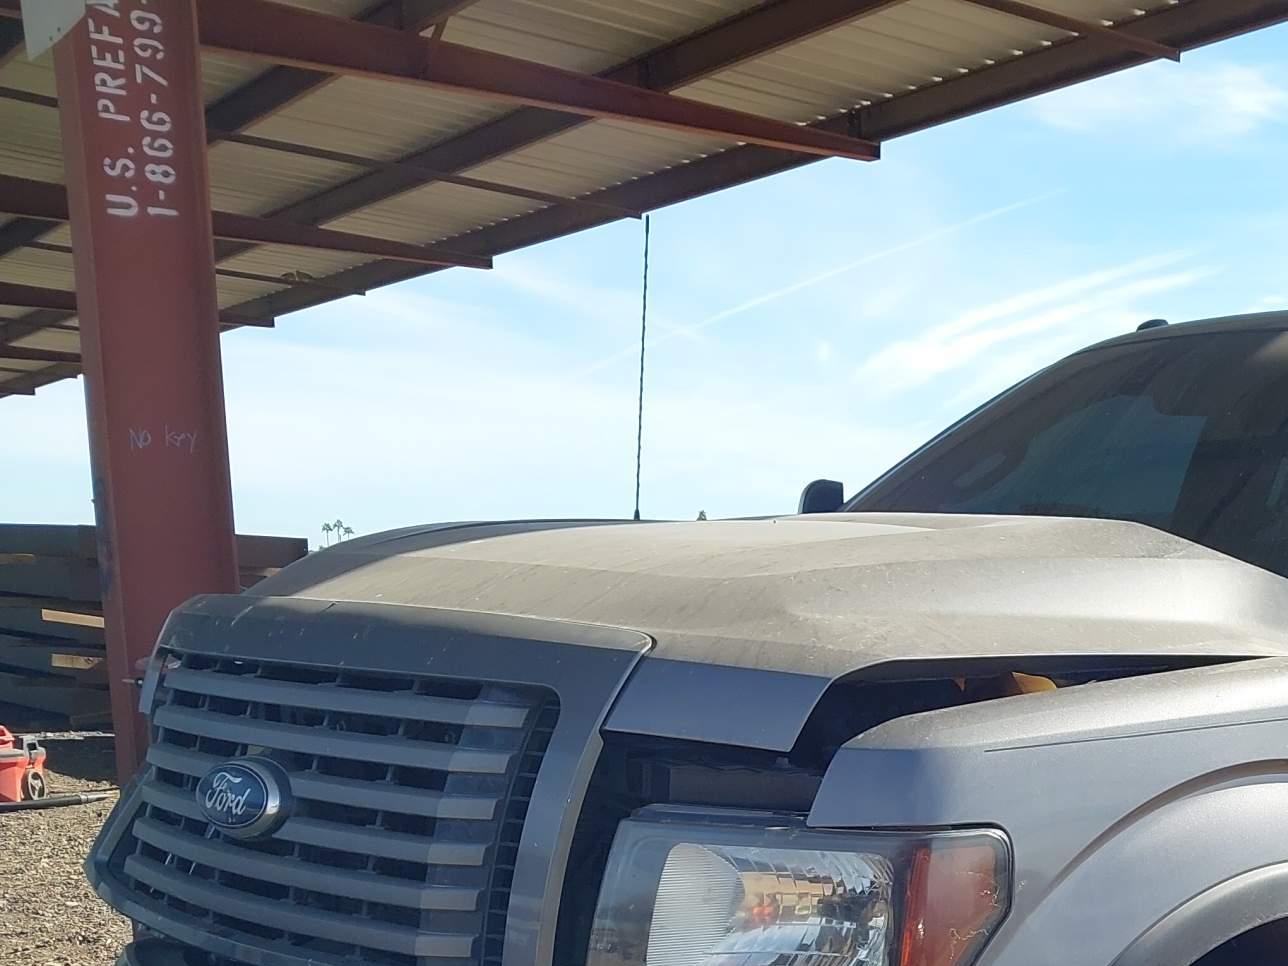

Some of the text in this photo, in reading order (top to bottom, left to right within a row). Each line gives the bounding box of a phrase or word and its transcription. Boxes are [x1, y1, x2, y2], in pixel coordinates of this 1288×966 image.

[130, 0, 179, 216] 1-866-799
[103, 146, 138, 217] U.S.
[205, 771, 252, 816] Ford
